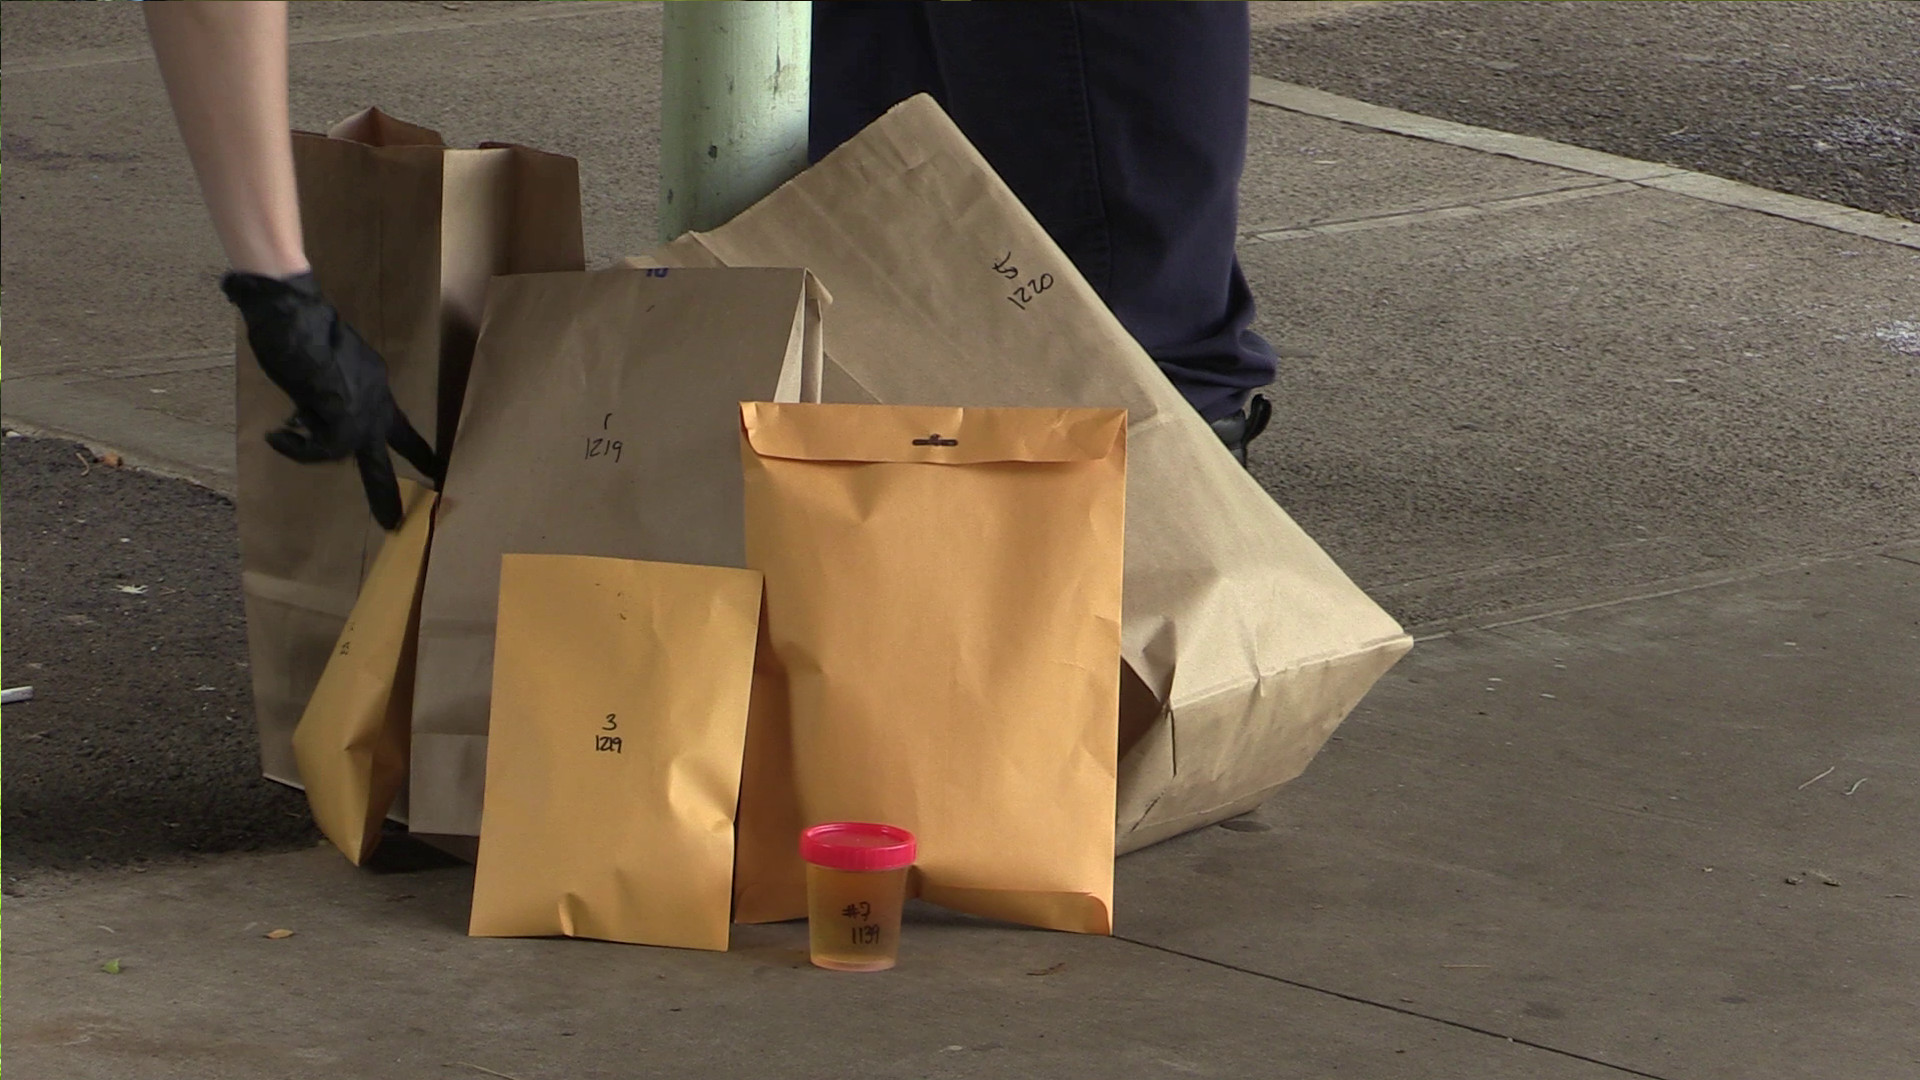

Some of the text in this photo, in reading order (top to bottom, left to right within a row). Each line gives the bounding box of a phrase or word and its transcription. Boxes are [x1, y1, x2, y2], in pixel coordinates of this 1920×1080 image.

[1007, 273, 1054, 311] 1220
[584, 437, 624, 464] 1219
[601, 713, 618, 731] 3
[595, 734, 623, 754] 1219
[851, 924, 880, 945] 1139
